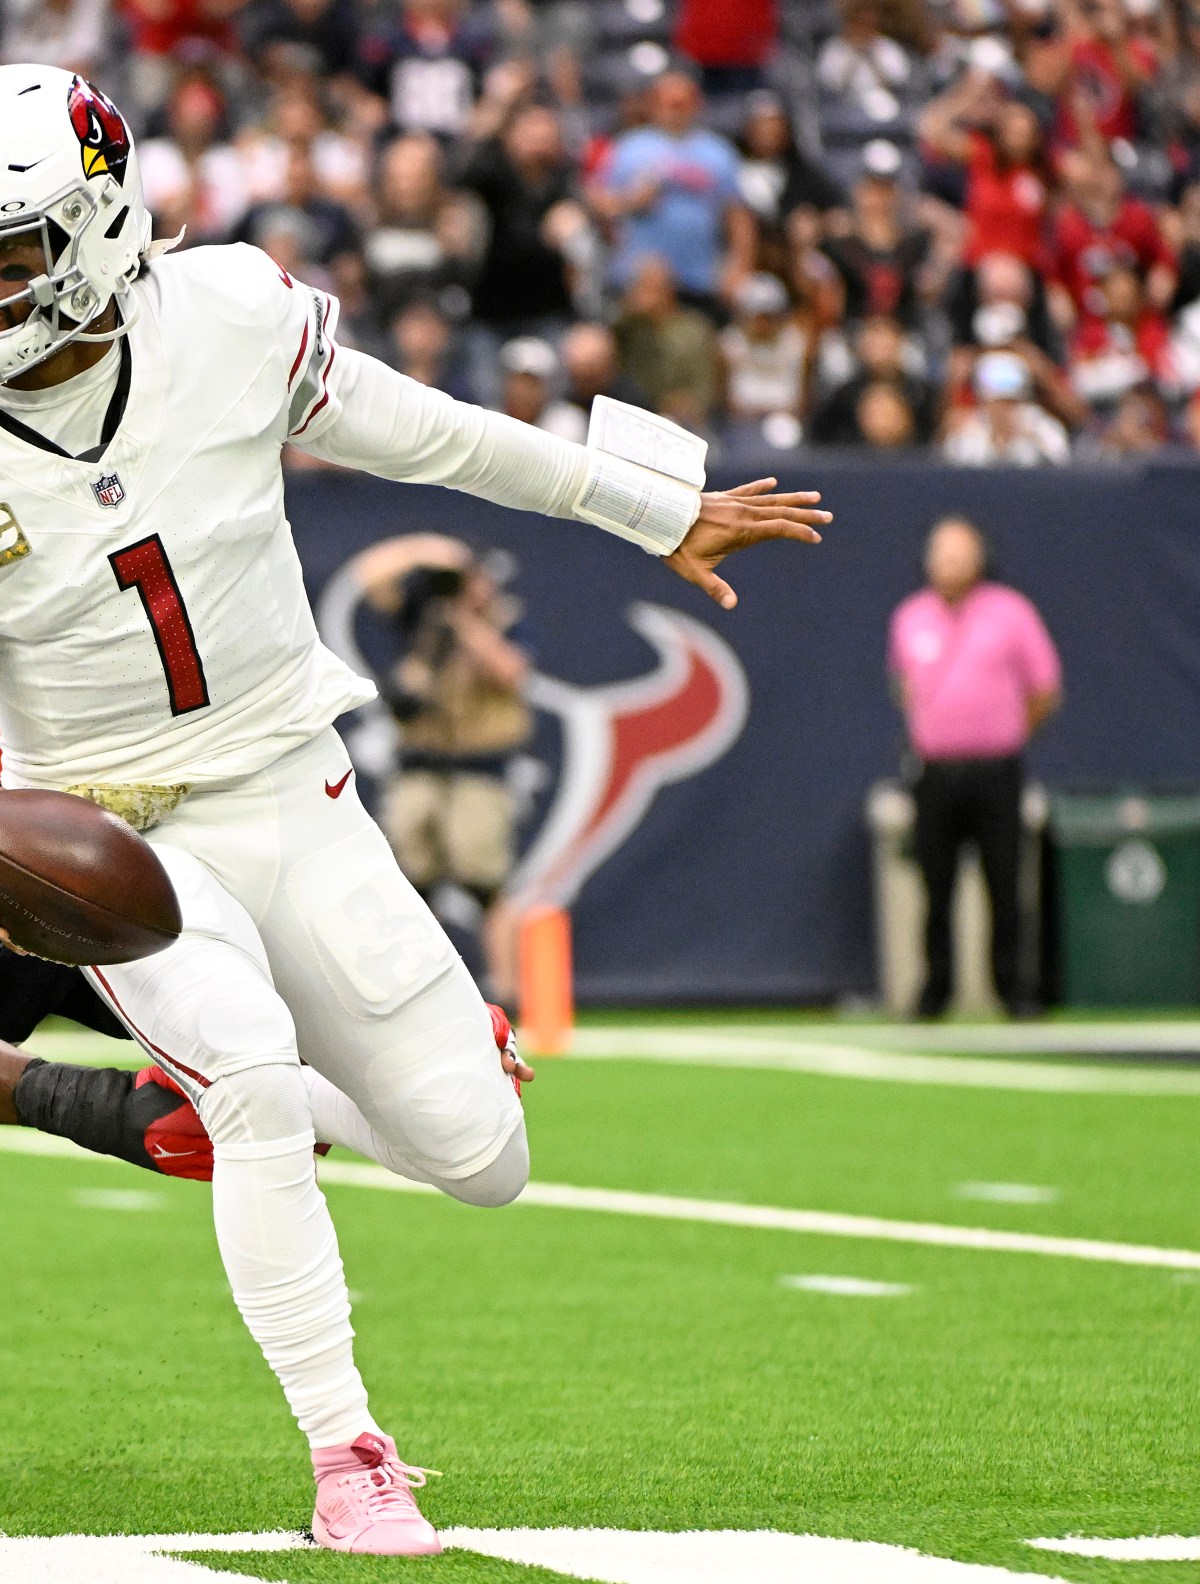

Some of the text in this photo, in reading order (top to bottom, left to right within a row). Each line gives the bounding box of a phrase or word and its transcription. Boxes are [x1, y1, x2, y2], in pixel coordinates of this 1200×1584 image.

[99, 485, 123, 504] NFL
[107, 532, 211, 717] 1
[22, 907, 73, 939] FOOTBALL
[76, 935, 125, 950] NATIONAL
